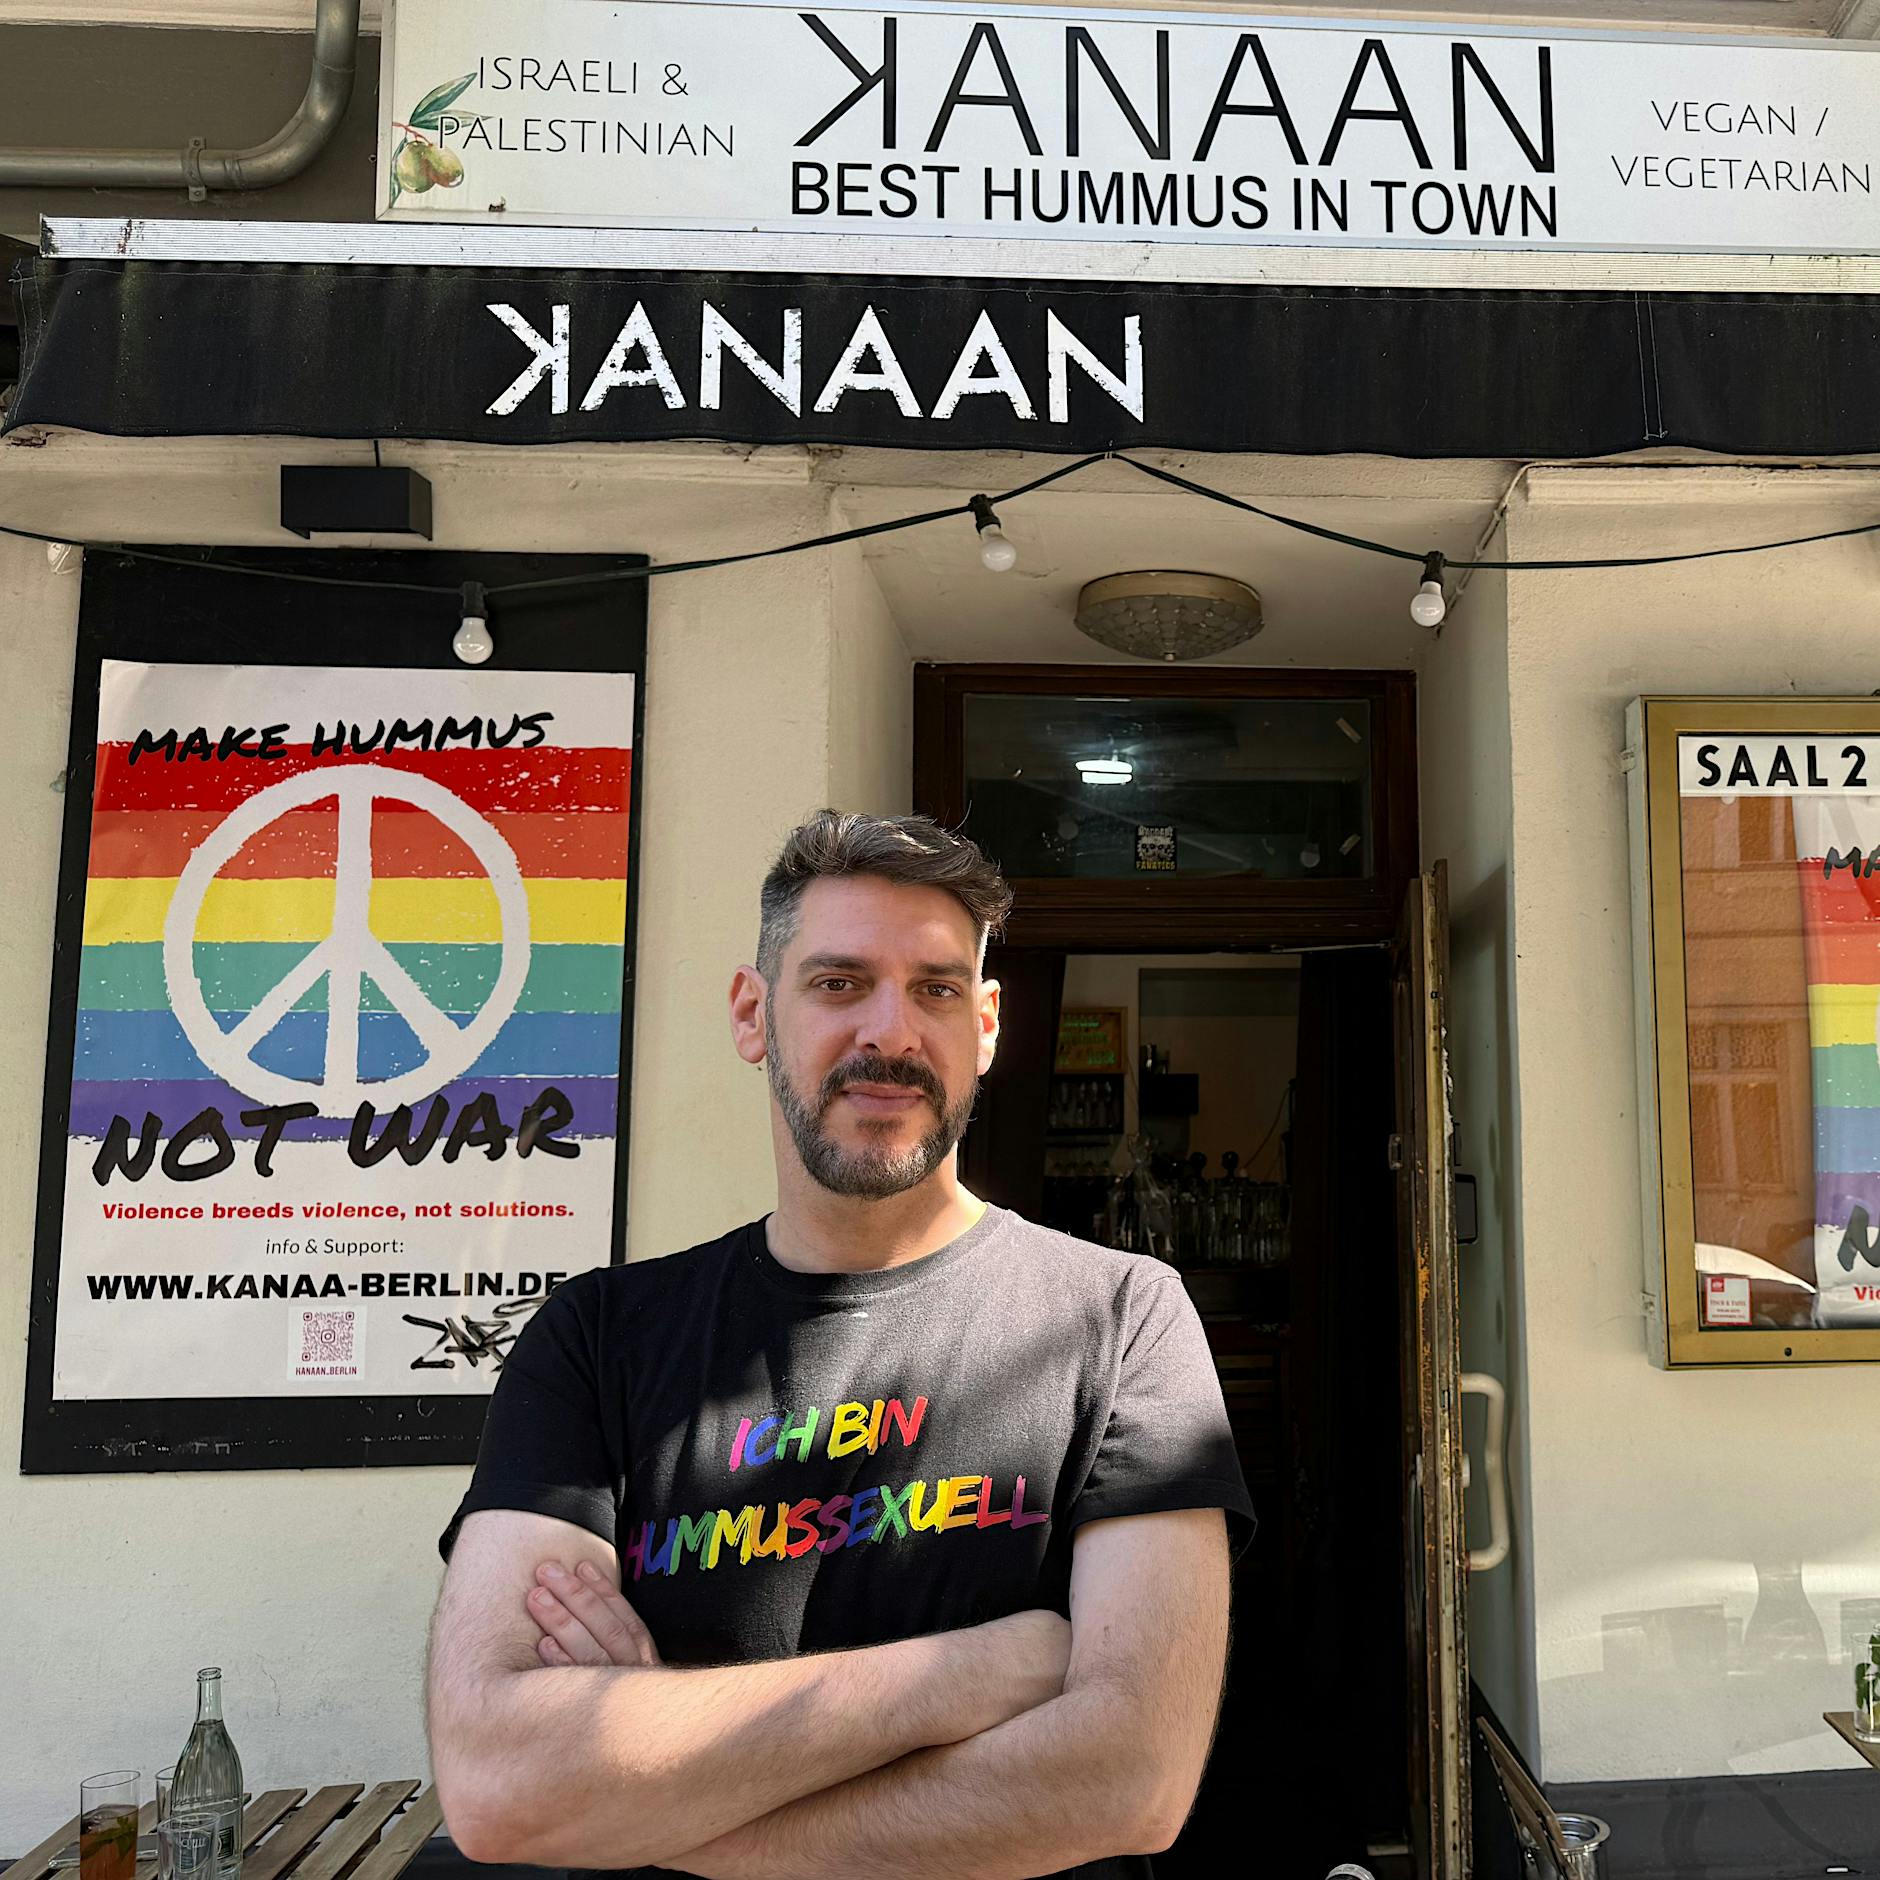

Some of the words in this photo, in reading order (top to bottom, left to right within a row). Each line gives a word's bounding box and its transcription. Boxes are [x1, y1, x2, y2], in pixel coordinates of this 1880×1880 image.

[478, 56, 638, 94] ISRAELI
[662, 63, 689, 96] &
[792, 13, 1556, 174] KANAAN
[438, 116, 734, 157] PALESTINIAN
[1650, 100, 1797, 136] VEGAN
[1815, 107, 1830, 137] /
[1610, 155, 1871, 194] VEGETARIAN
[791, 161, 960, 219] BEST
[984, 167, 1268, 230] HUMMUS
[1293, 177, 1348, 232] IN
[1370, 180, 1557, 238] TOWN
[485, 300, 1145, 424] KANAAN
[128, 723, 289, 766] MAKE
[310, 712, 555, 757] HUMMUS
[1697, 744, 1829, 787] SAAL
[1840, 745, 1868, 787] 2
[92, 1102, 320, 1187] NOT
[347, 1087, 581, 1169] WAR
[102, 1202, 204, 1219] Violence
[212, 1202, 295, 1219] breeds
[302, 1202, 407, 1221] violence,
[414, 1202, 453, 1218] not
[459, 1201, 575, 1218] solutions.
[266, 1238, 300, 1255] info
[305, 1239, 318, 1254] &
[324, 1238, 404, 1258] Support:
[728, 1405, 820, 1472] ICH
[828, 1396, 928, 1460] BIN
[624, 1475, 1048, 1581] HUMMUSSEXUELL
